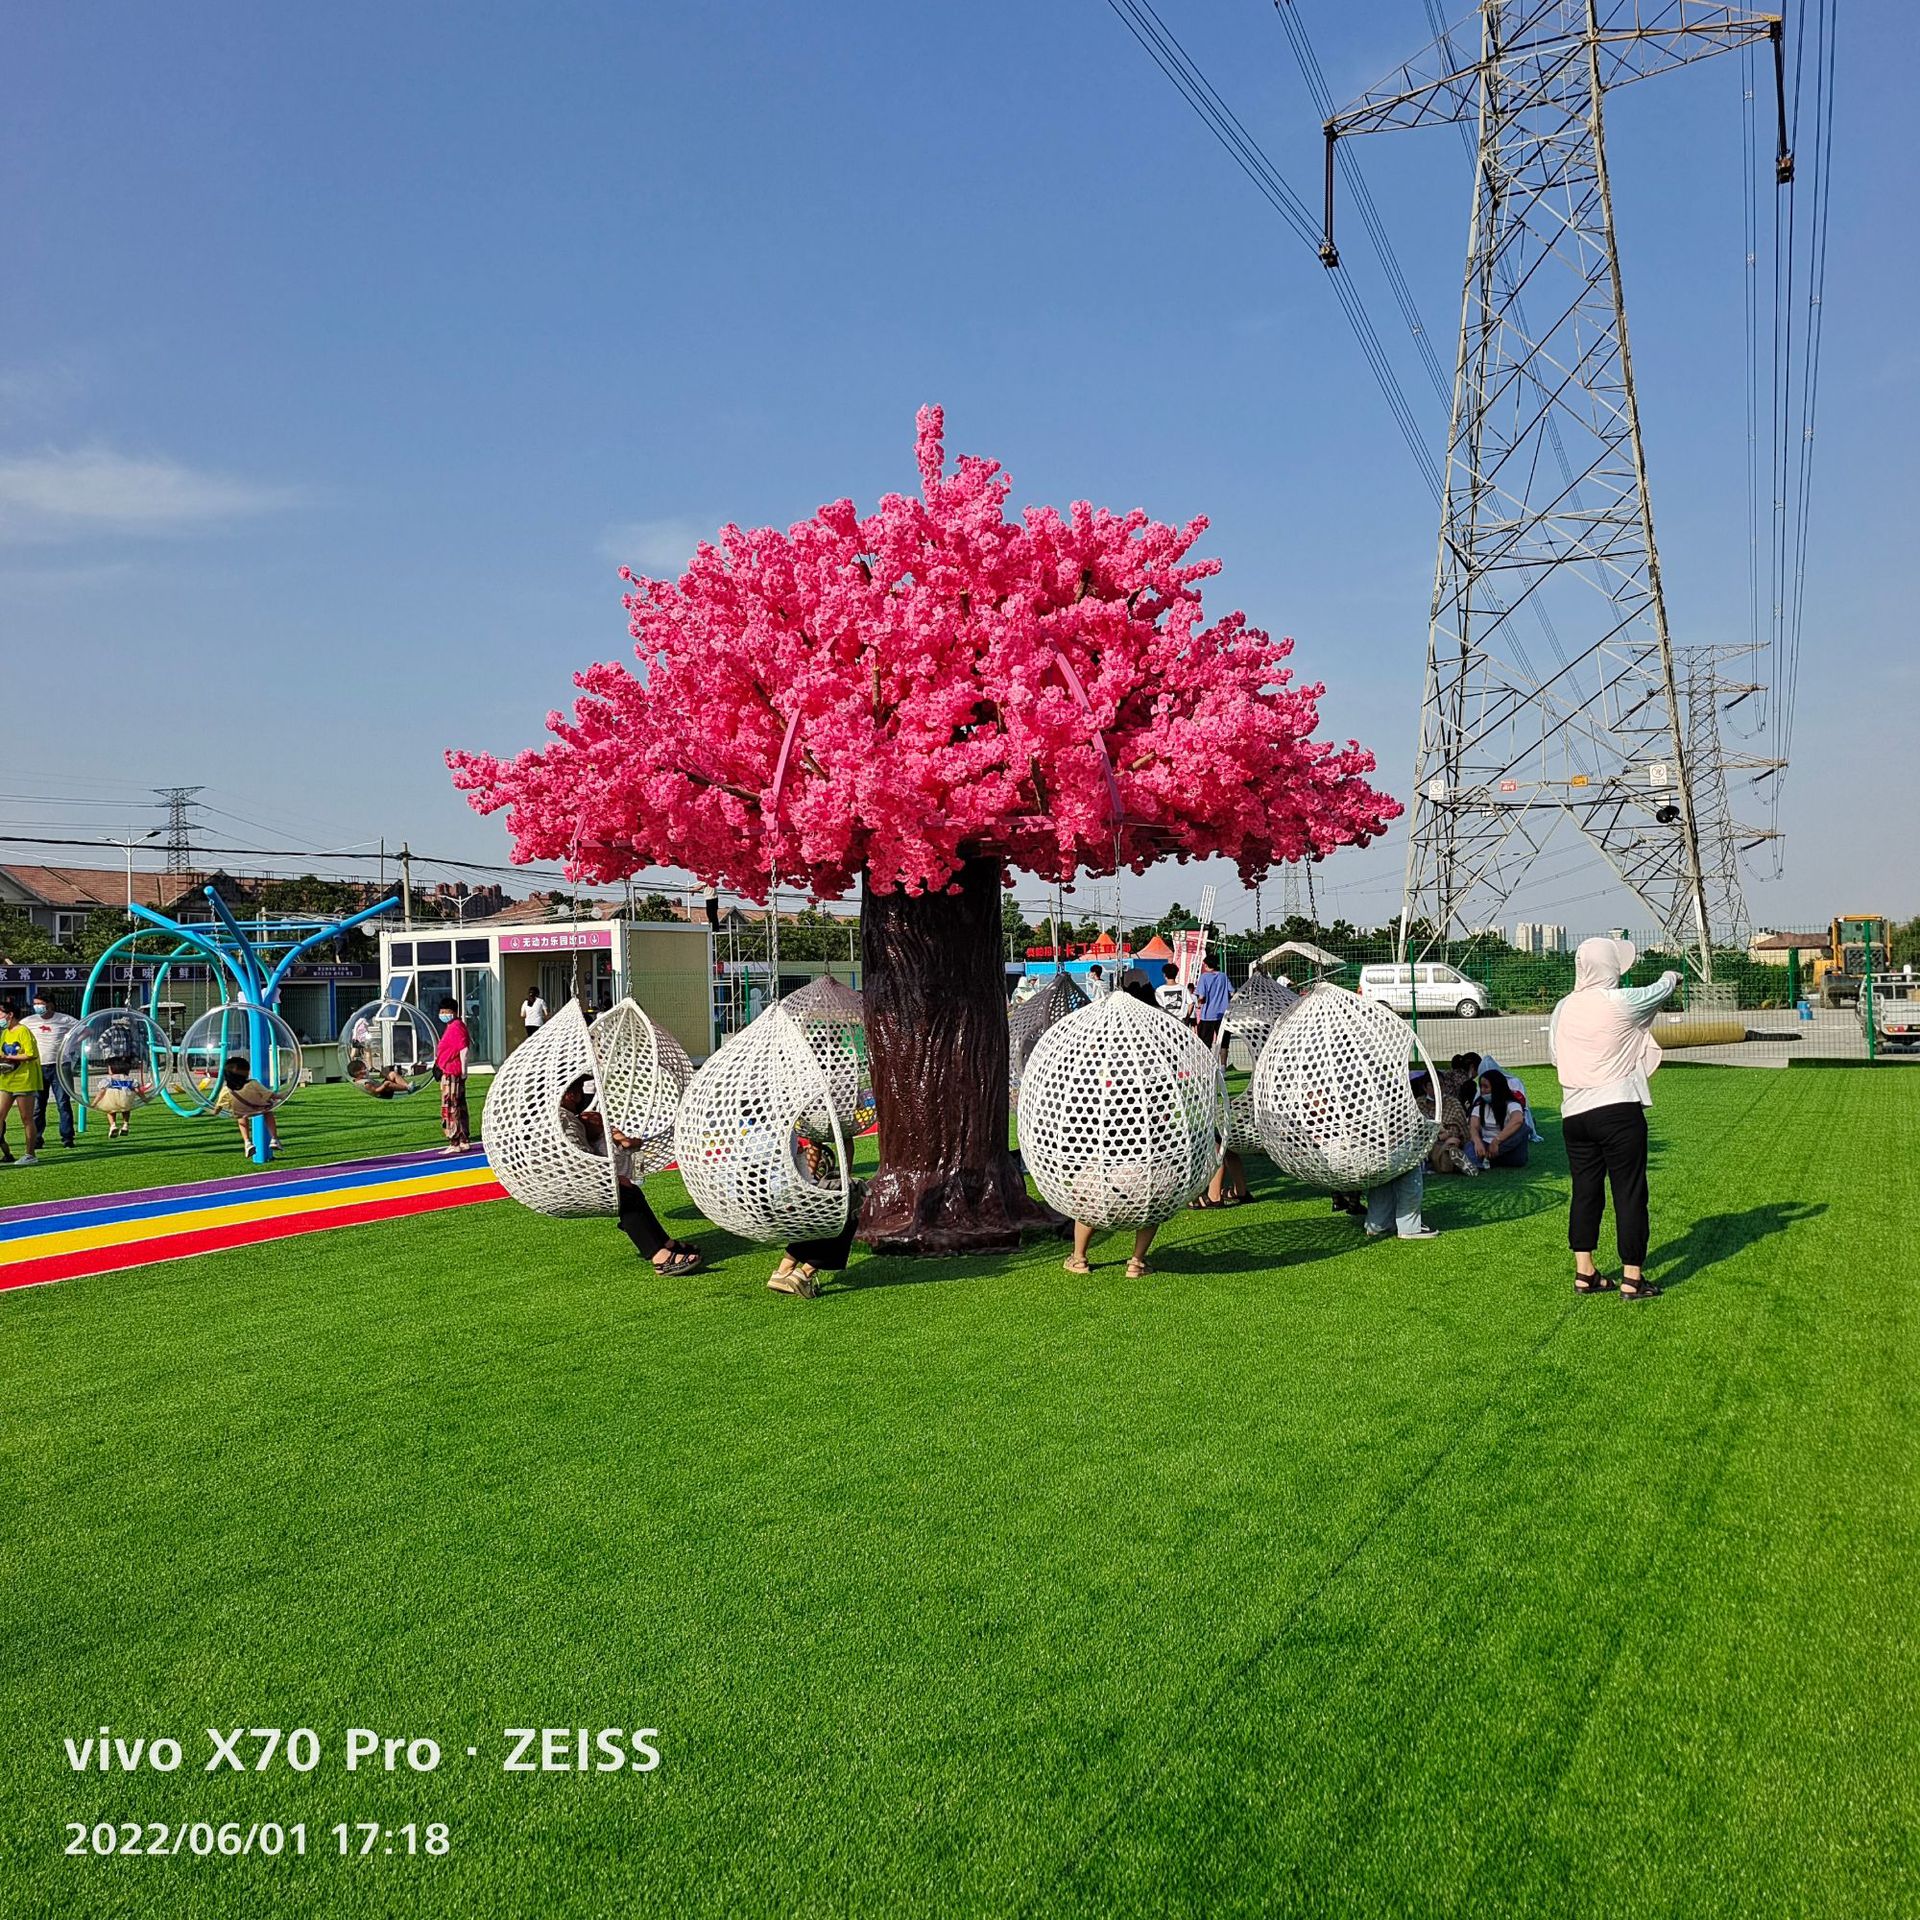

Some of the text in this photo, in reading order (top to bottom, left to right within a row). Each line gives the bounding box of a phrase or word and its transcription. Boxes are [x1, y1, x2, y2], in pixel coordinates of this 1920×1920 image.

[522, 934, 587, 948] 无动力乐园出口
